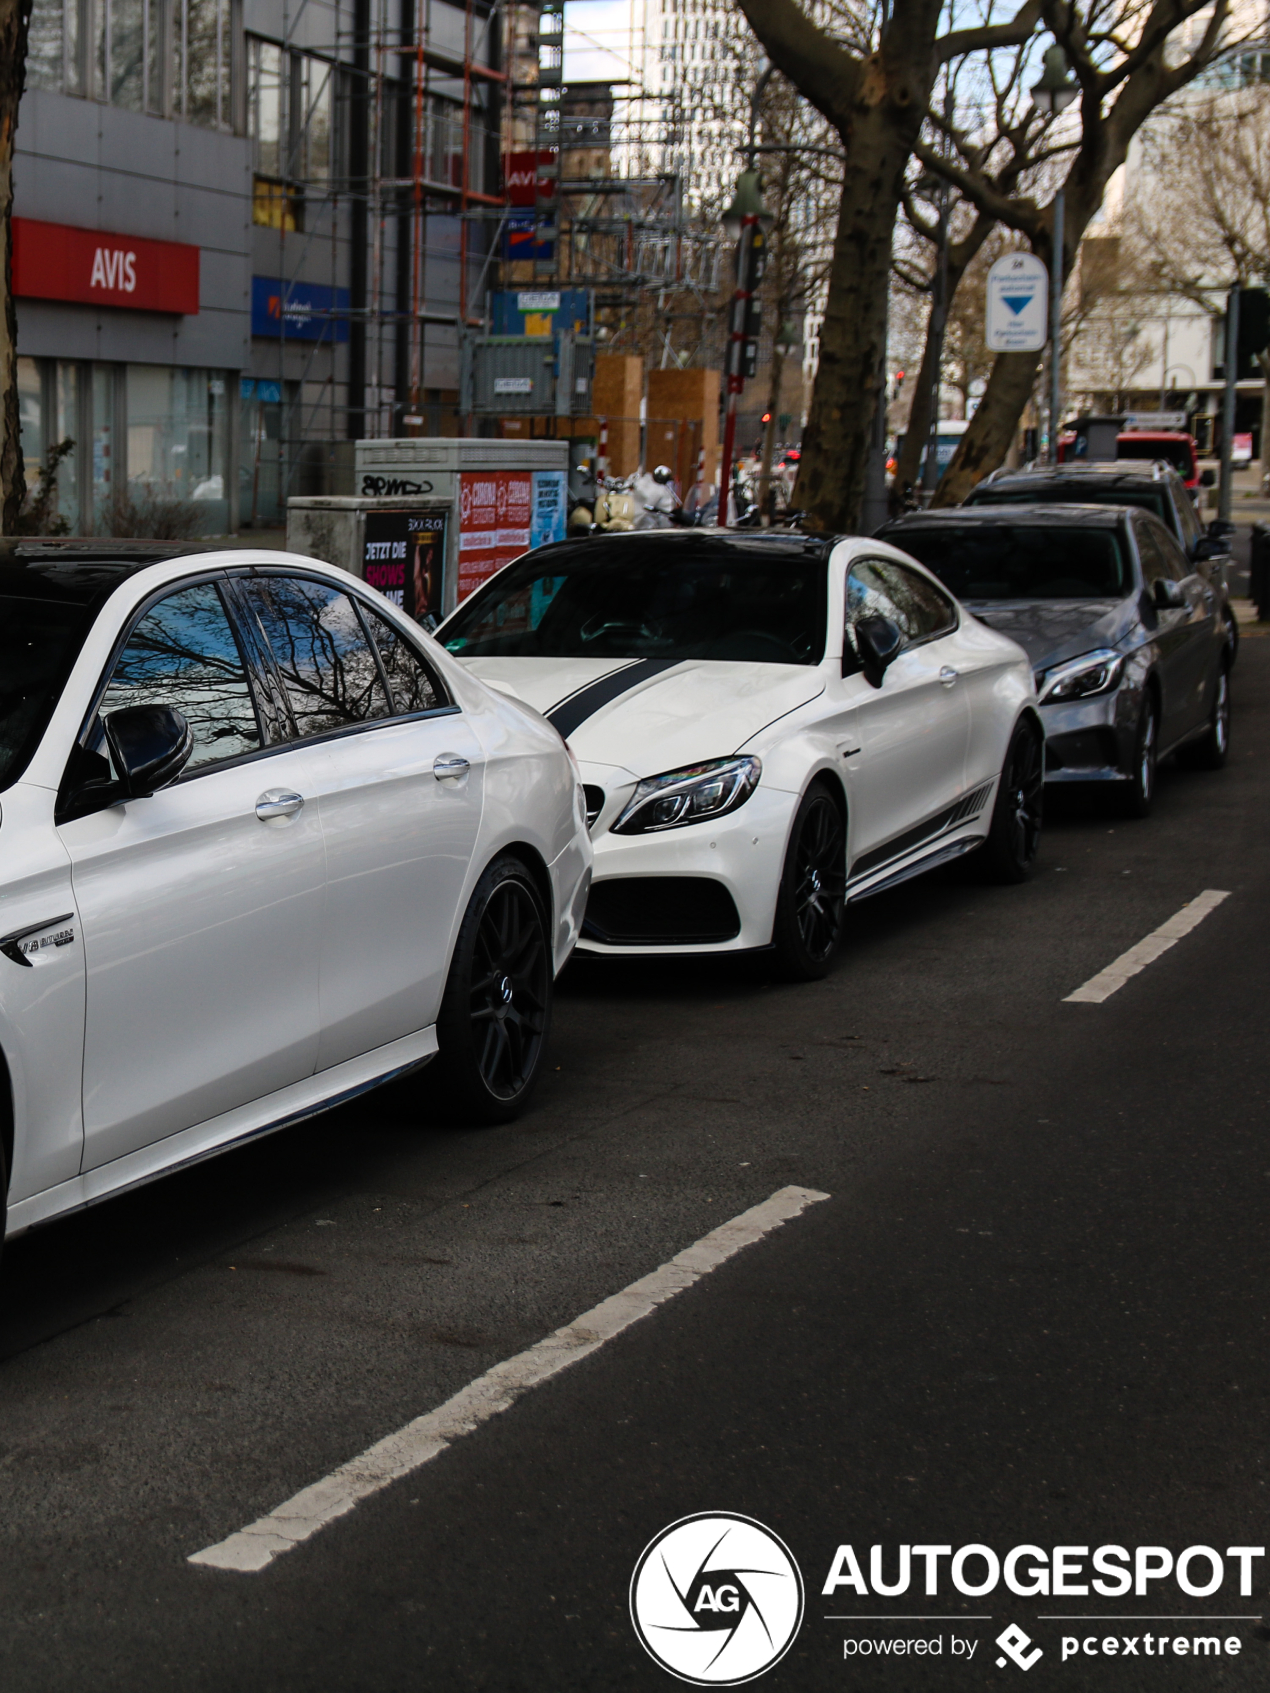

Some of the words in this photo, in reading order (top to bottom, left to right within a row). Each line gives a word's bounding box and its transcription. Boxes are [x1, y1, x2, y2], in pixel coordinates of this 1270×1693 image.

[90, 247, 137, 293] AVIS
[365, 542, 391, 560] JETZT
[392, 541, 407, 558] DIE
[366, 564, 406, 586] SHOWS
[381, 589, 405, 611] IVE
